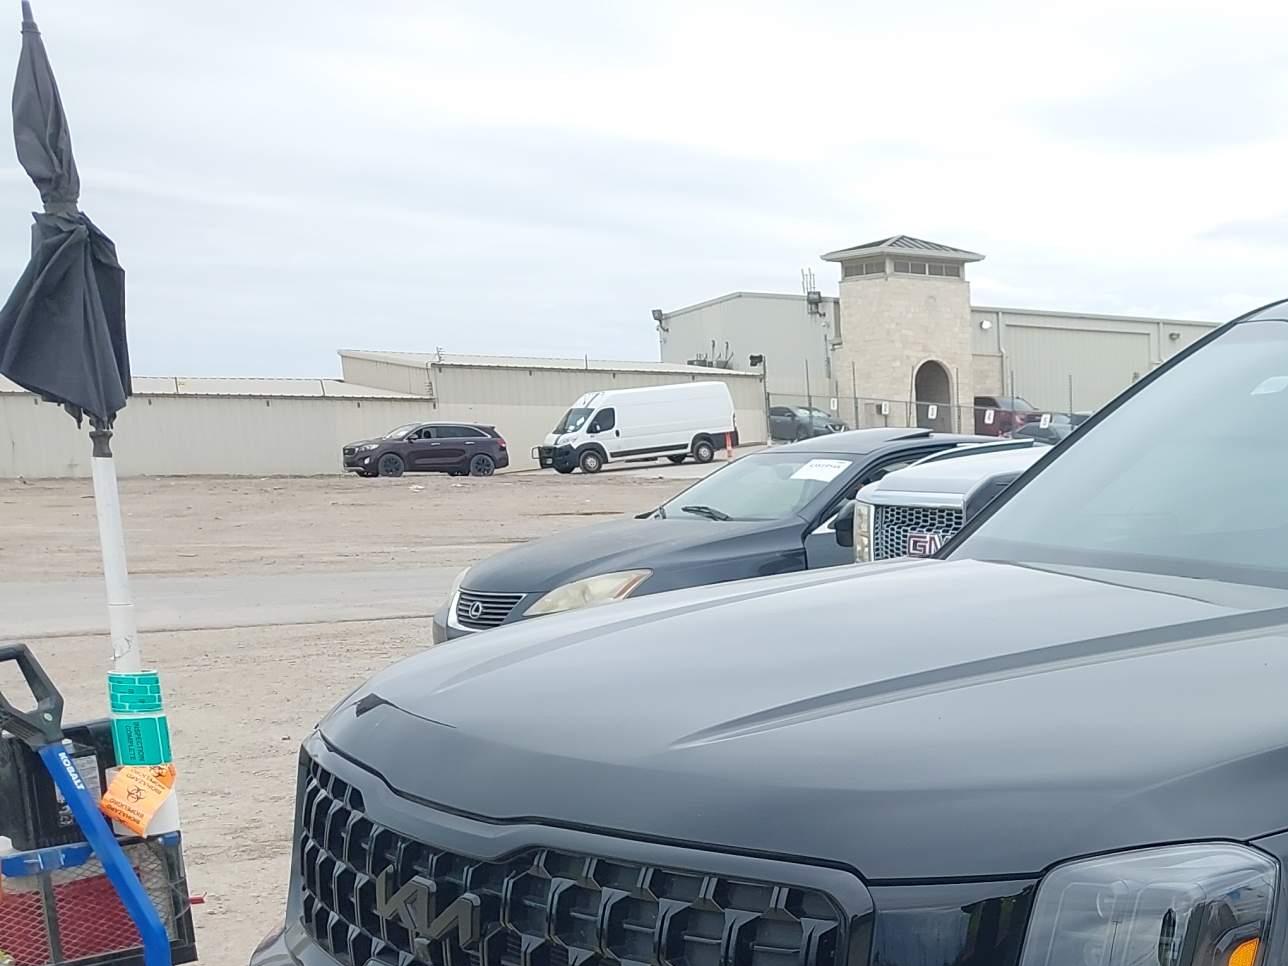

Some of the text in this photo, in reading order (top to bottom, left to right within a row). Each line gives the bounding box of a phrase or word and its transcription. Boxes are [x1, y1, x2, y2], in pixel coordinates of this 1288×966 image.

[908, 533, 956, 558] GM
[125, 724, 137, 761] COMPLETE
[133, 721, 145, 762] INSPECTION
[58, 751, 86, 791] KOBALT
